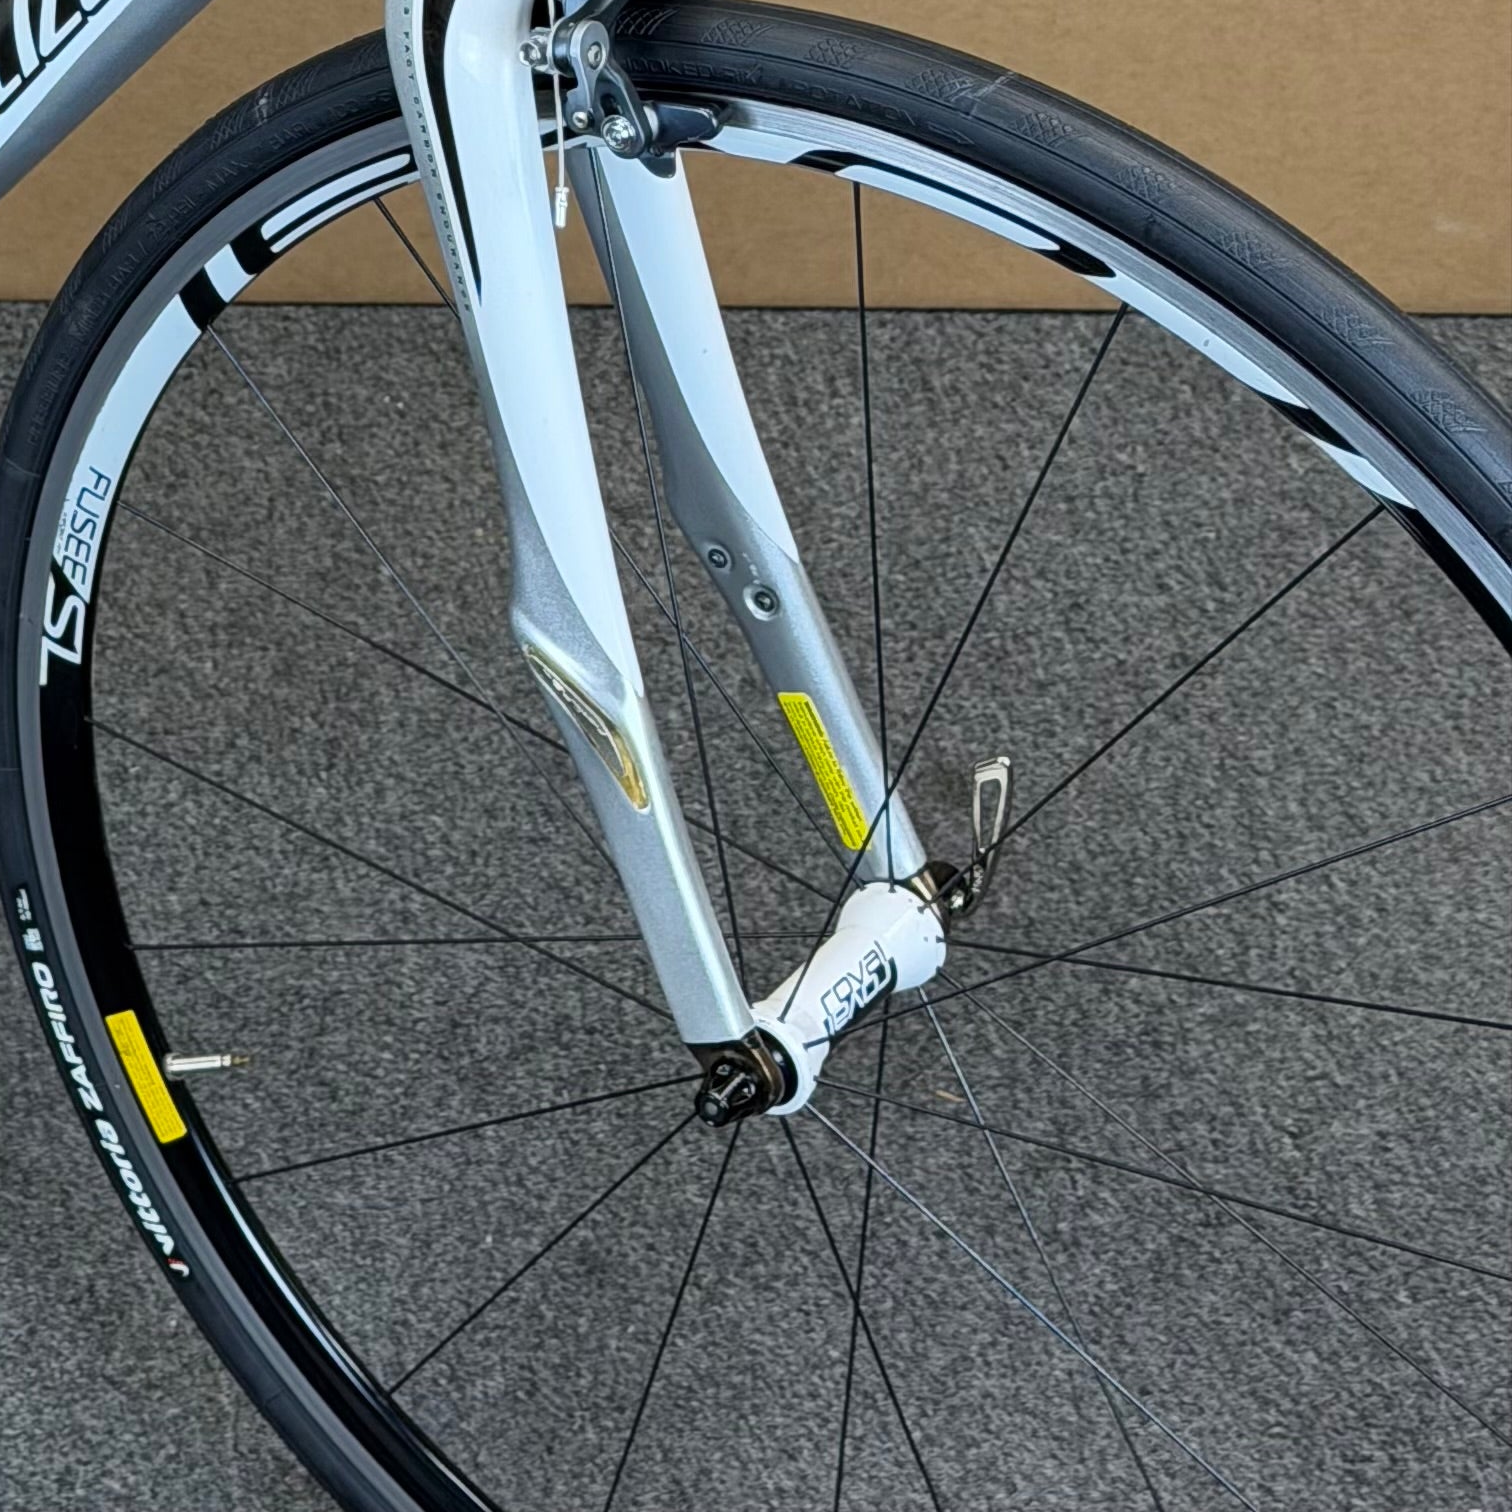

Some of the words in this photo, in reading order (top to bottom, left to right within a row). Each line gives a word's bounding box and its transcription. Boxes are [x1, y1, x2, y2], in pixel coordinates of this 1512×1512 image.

[413, 96, 437, 179] CARBON
[436, 192, 471, 313] ENDURANCE
[61, 465, 112, 586] FUSEE
[39, 571, 86, 687] SL
[32, 961, 104, 1112] ZAFFIRO
